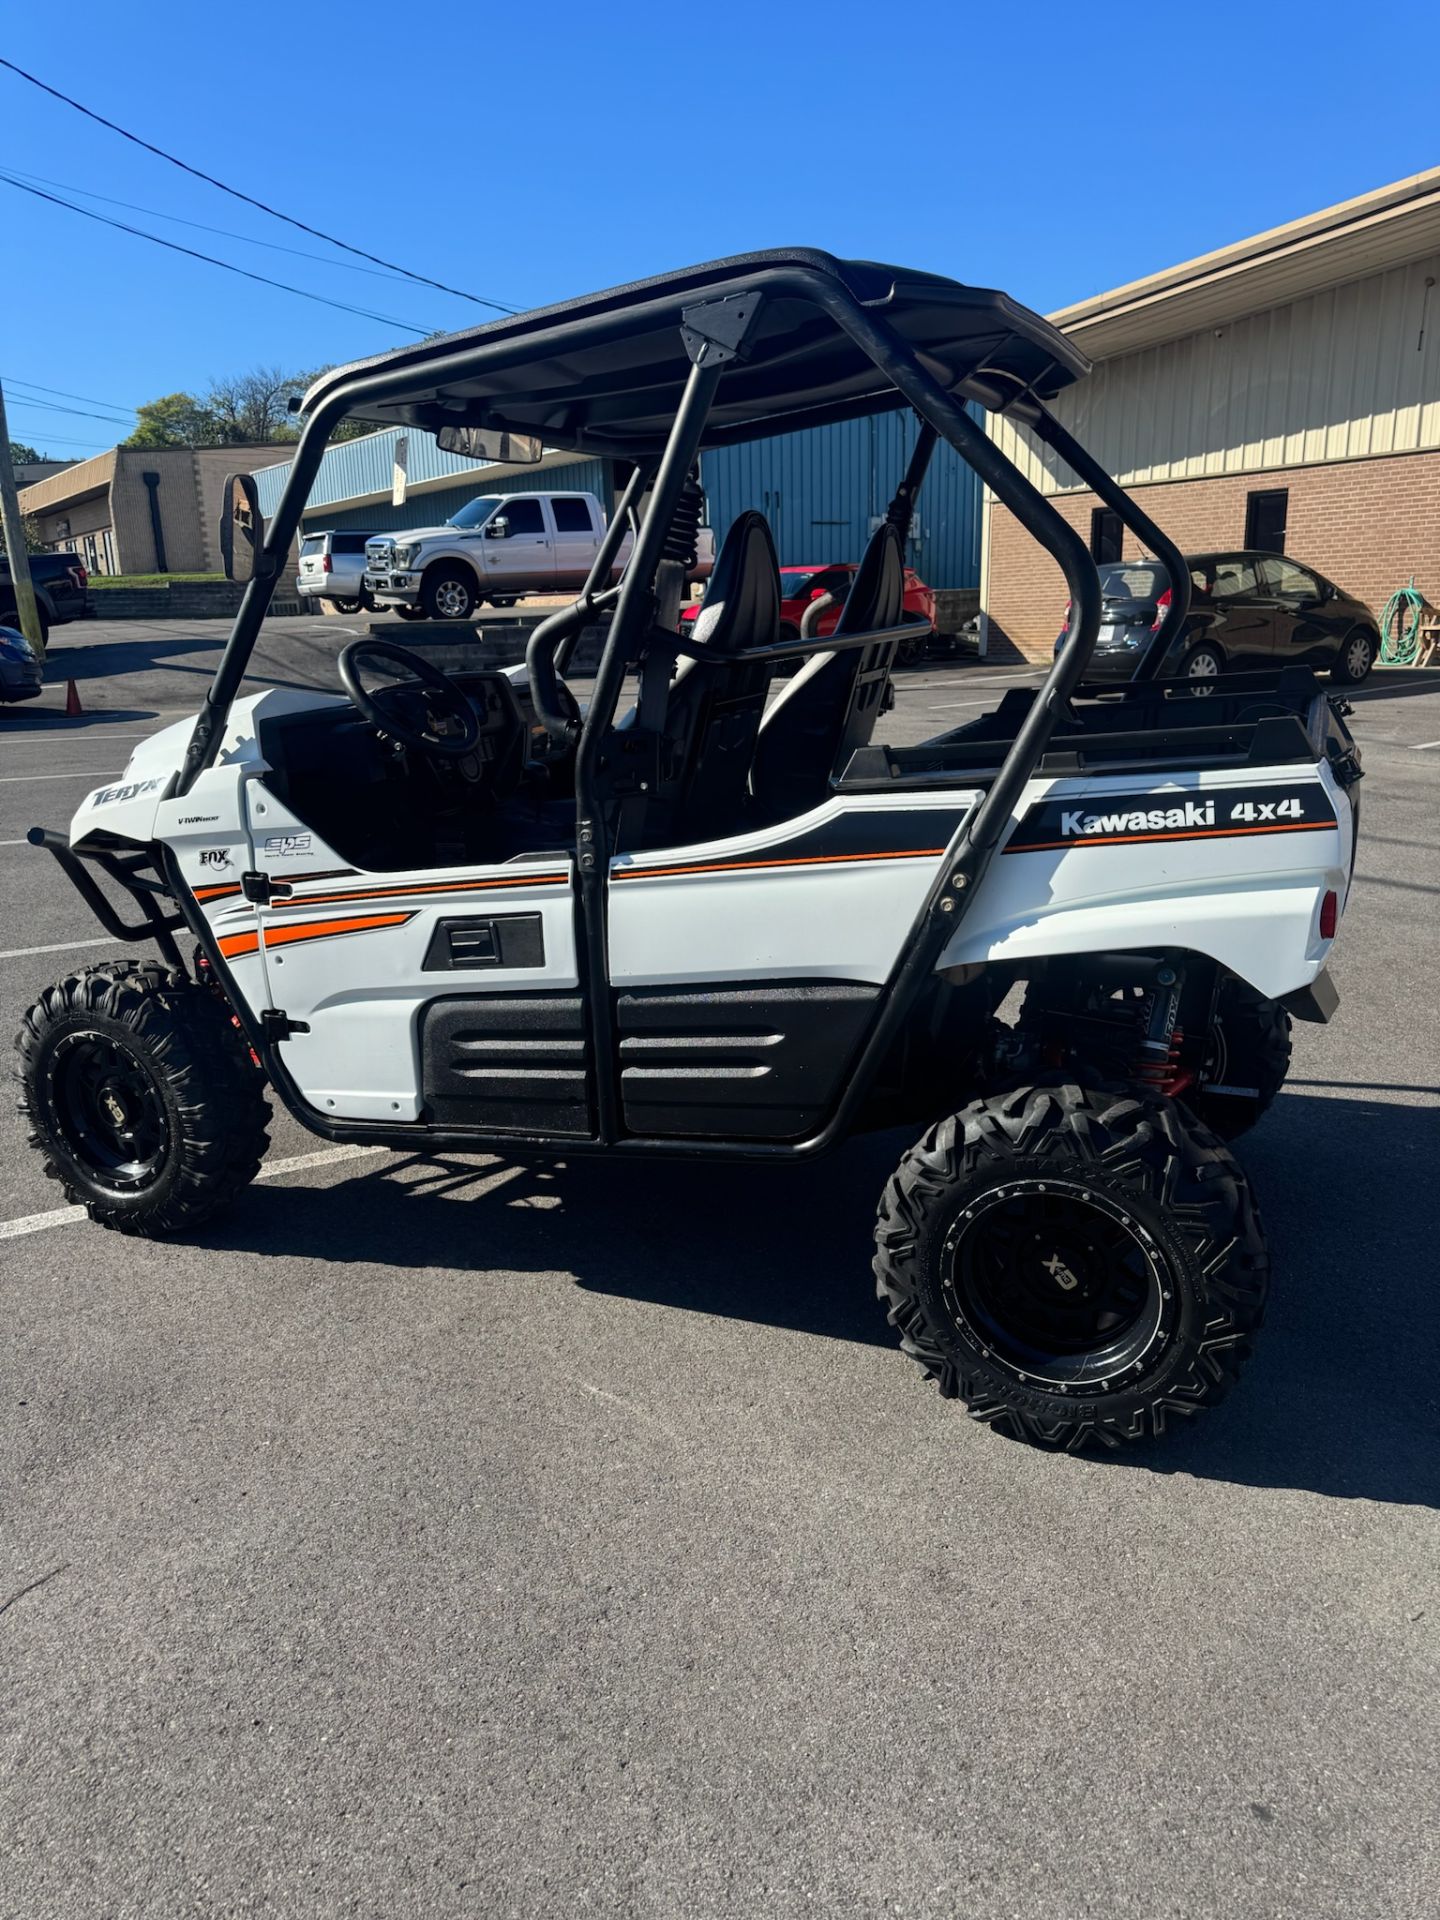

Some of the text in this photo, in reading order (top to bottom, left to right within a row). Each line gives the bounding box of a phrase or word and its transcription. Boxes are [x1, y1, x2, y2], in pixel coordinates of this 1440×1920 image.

[1061, 798, 1305, 836] Kawasaki 4x4
[199, 848, 231, 867] FOX
[1041, 1253, 1078, 1290] XD
